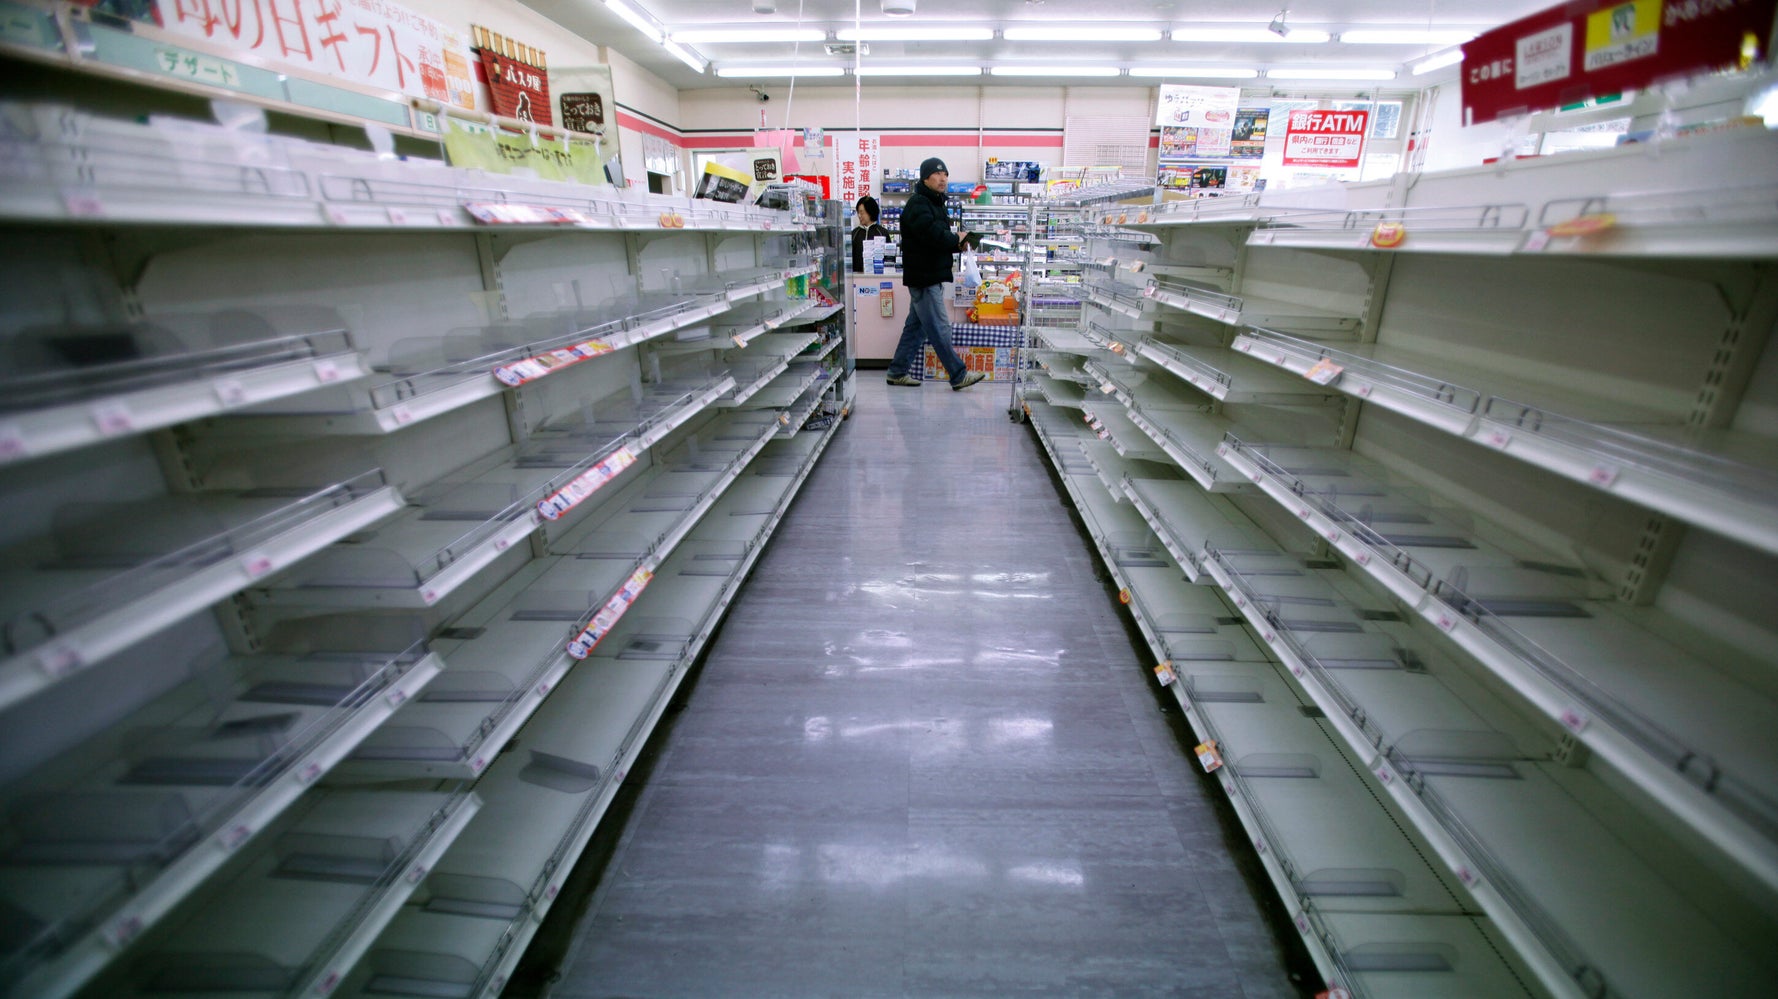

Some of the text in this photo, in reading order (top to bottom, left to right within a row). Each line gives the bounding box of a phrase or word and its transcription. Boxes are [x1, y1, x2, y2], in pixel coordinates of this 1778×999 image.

[505, 65, 541, 92] パスタ屋
[563, 102, 601, 117] とっておき
[1291, 114, 1364, 132] 銀行ATM
[842, 161, 855, 202] 実施中
[858, 138, 870, 198] 年齢確認
